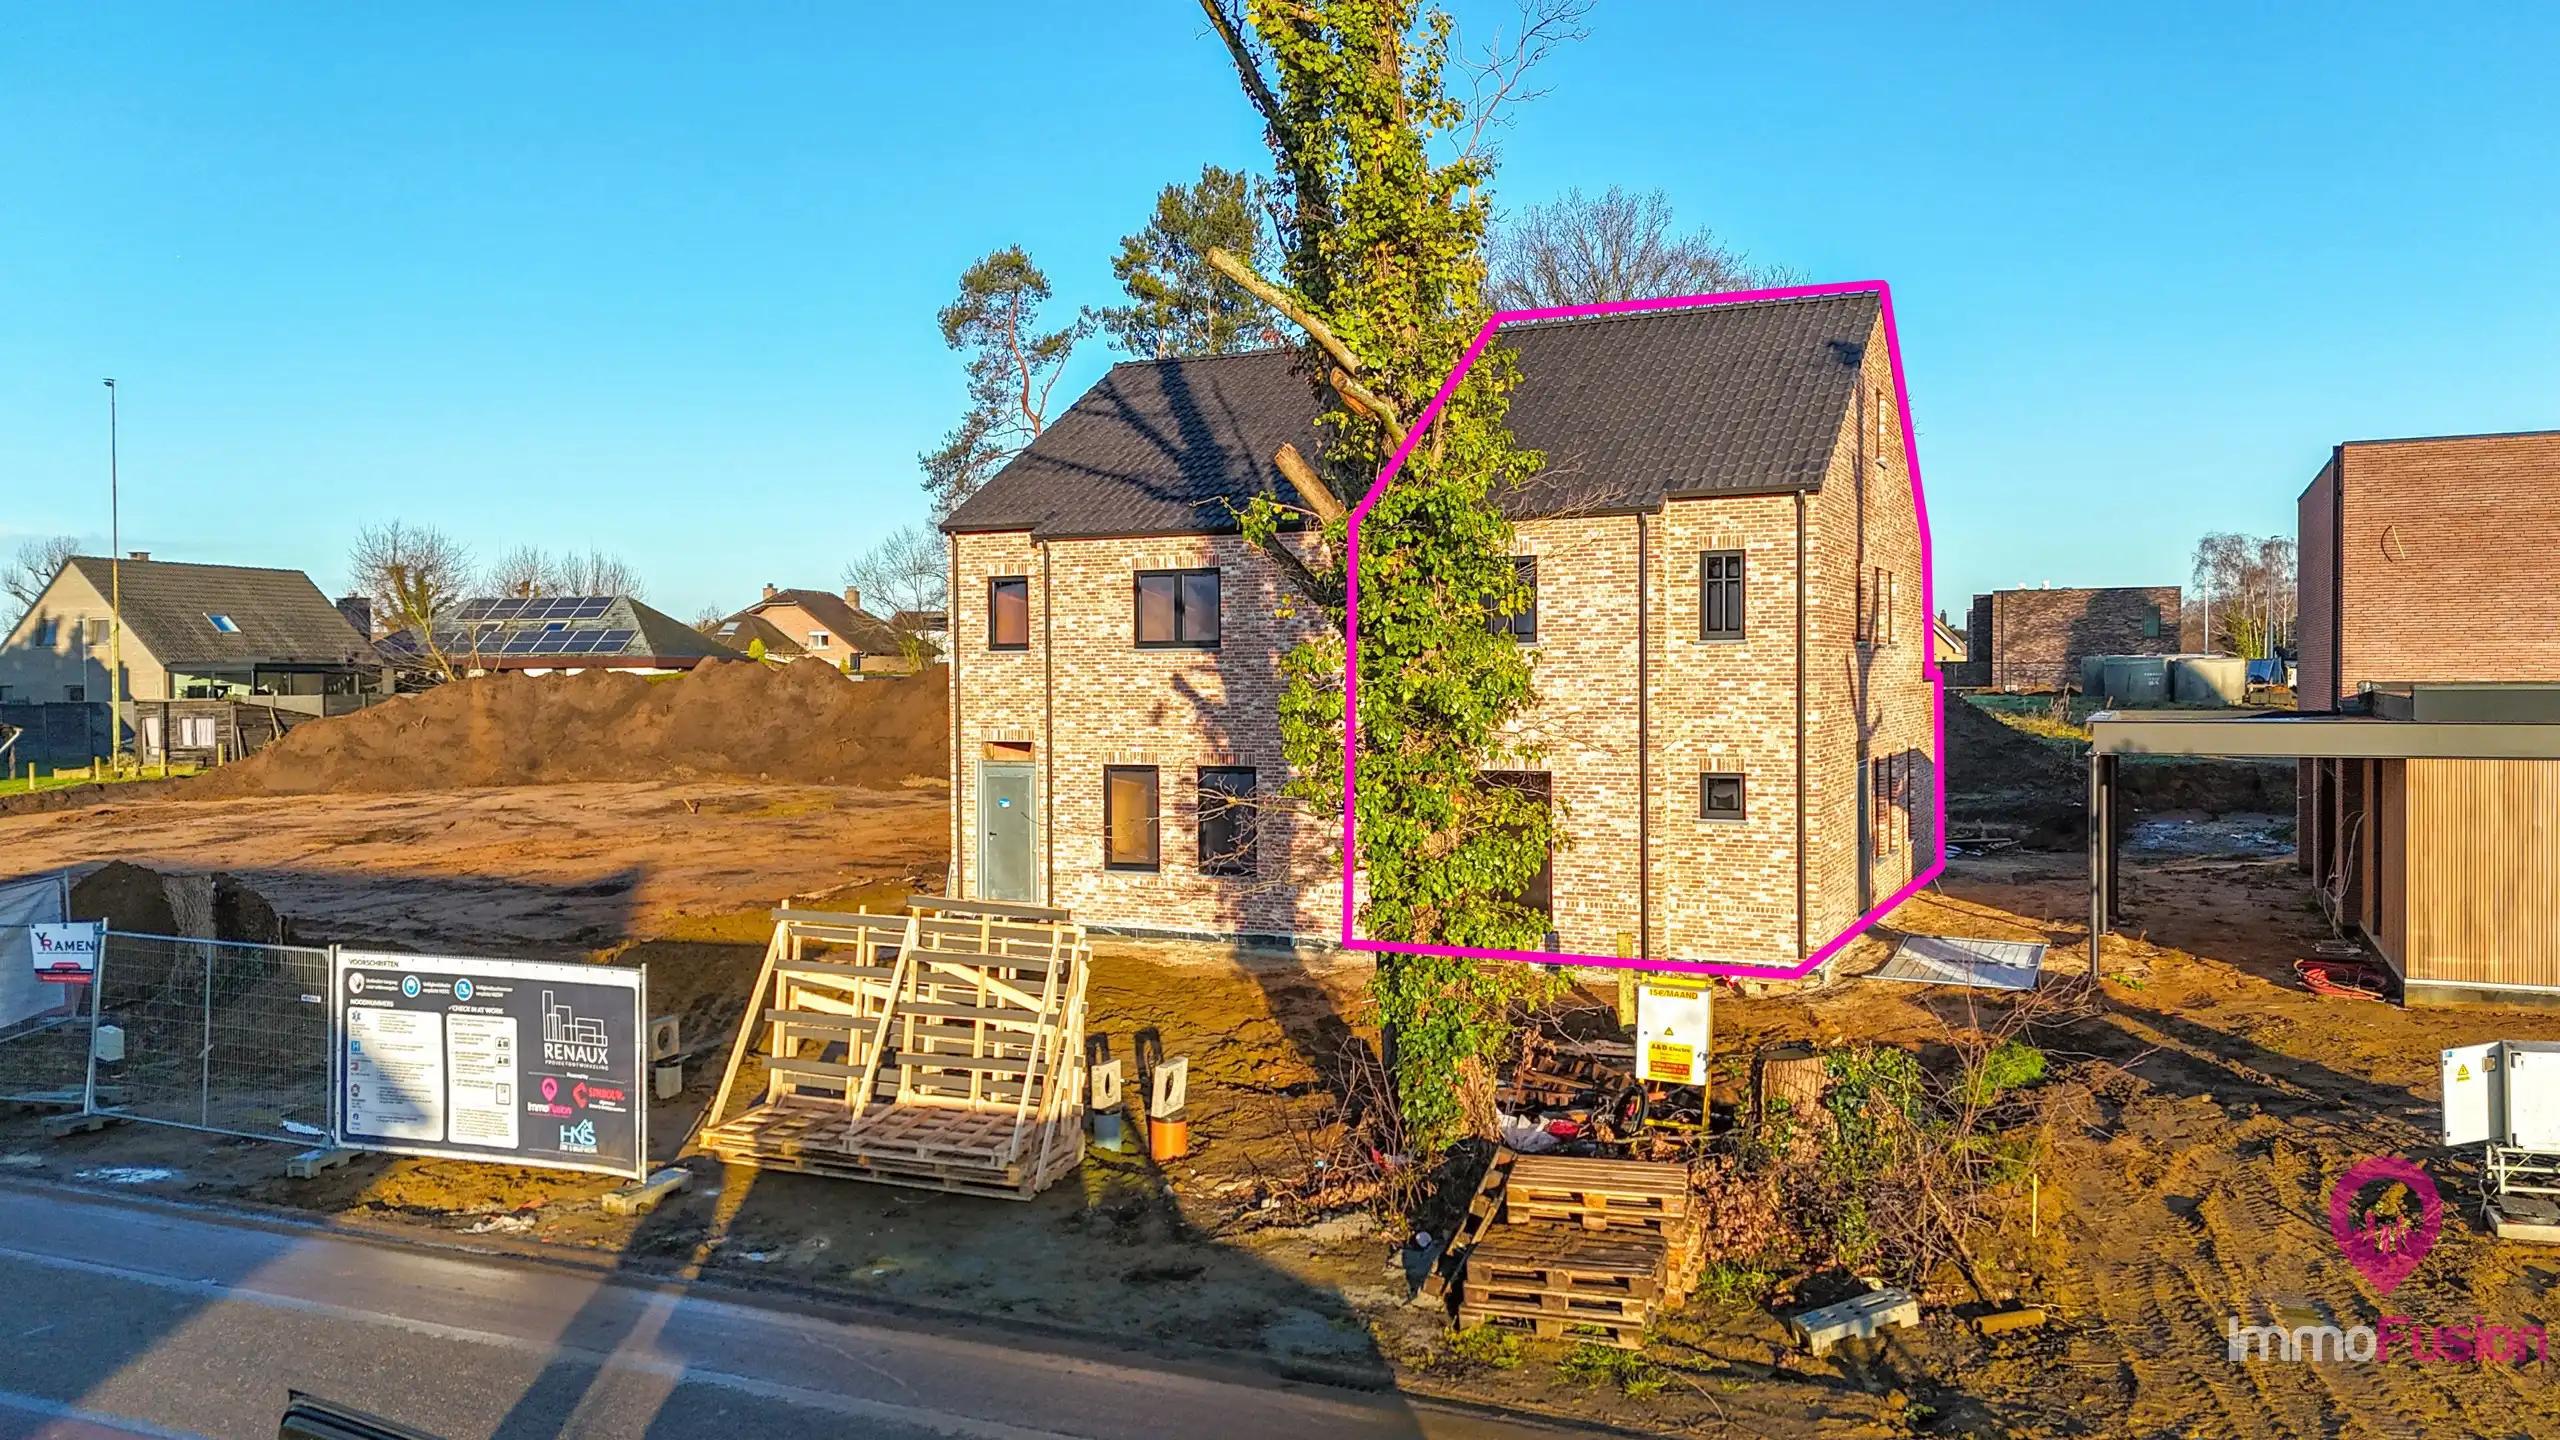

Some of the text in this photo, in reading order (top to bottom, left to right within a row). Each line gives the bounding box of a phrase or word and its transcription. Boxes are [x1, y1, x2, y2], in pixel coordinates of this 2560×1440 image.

[348, 958, 399, 968] VOORSCHRIFTEN
[1649, 988, 1698, 1000] 15€/MAAND
[350, 998, 394, 1008] NOODNUMMERS
[452, 1005, 470, 1013] CHECK
[485, 1007, 504, 1015] WORK
[544, 1043, 609, 1065] RENAUX
[527, 1101, 573, 1116] ImmoFusion
